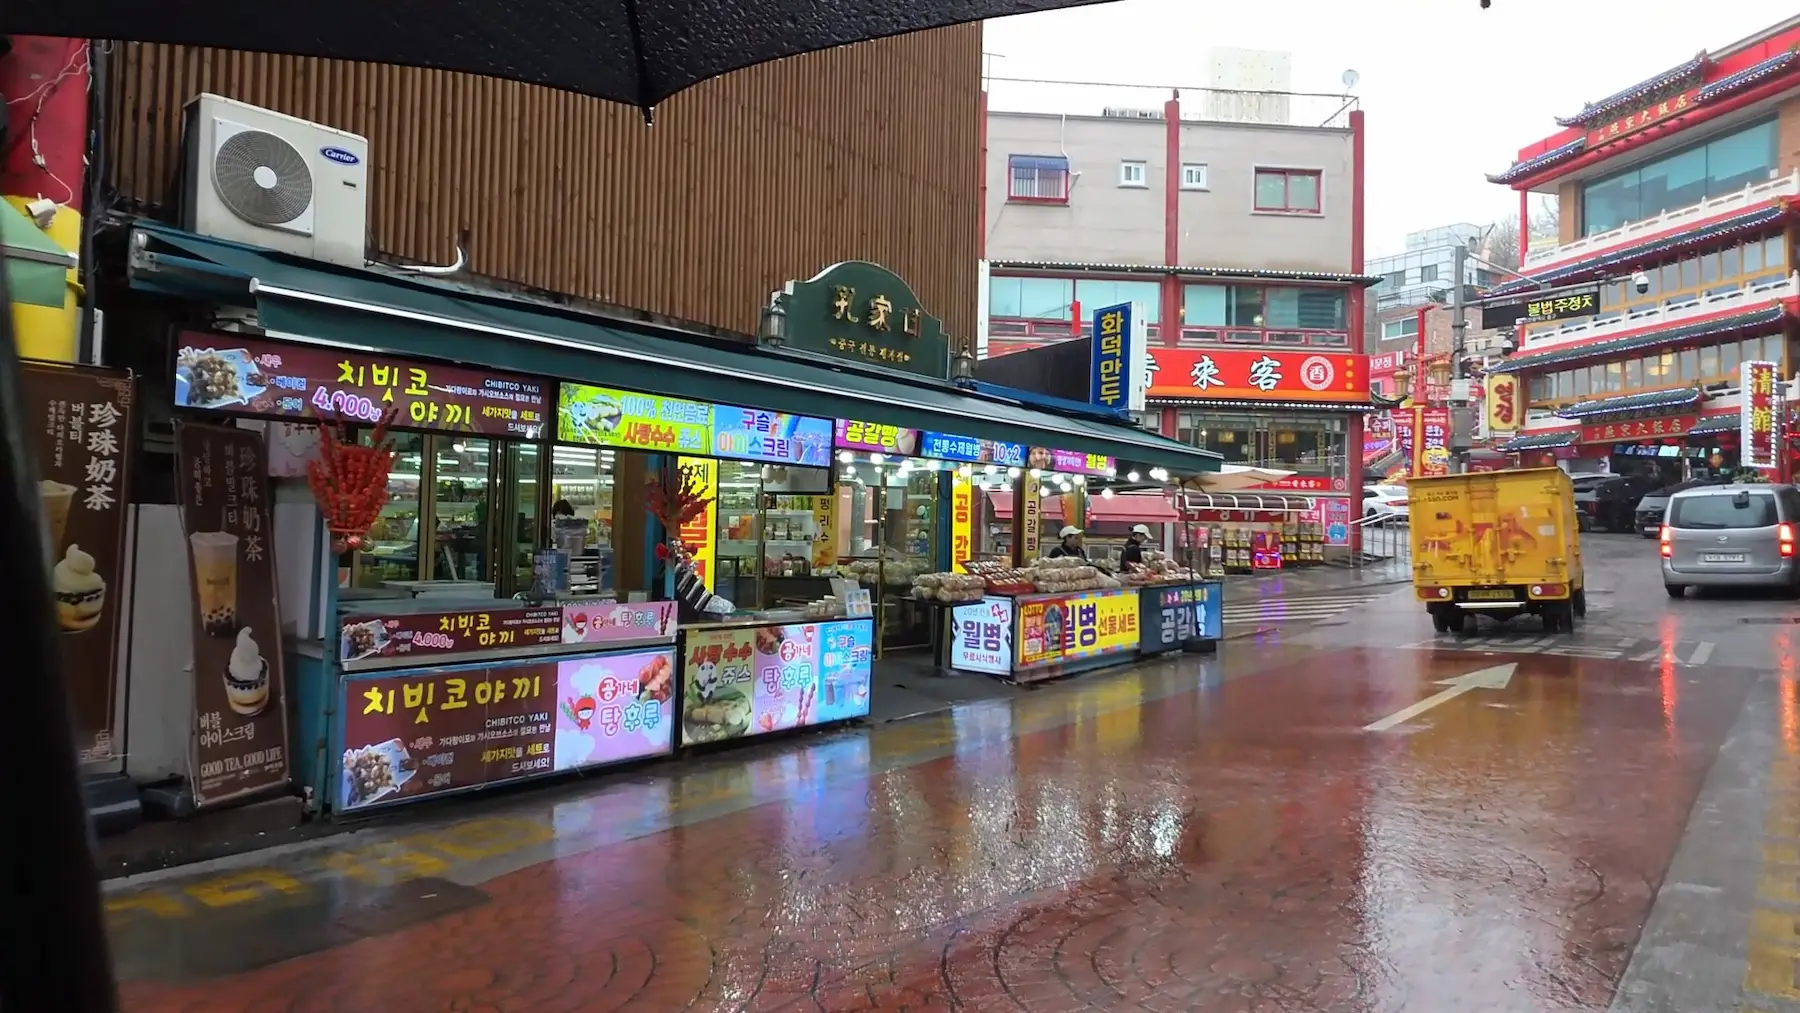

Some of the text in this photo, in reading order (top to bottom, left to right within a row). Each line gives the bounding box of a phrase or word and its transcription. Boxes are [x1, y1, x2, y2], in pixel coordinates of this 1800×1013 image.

[325, 149, 356, 163] Carrier
[1100, 311, 1124, 406] 화덕만두
[336, 359, 429, 403] 치빗코
[484, 379, 540, 394] CHIBITCO YAKI
[409, 401, 472, 425] 야끼
[620, 395, 657, 418] 100%
[1494, 381, 1514, 425] 연경
[69, 402, 85, 445] 버블티
[741, 410, 769, 433] 구슬
[846, 420, 898, 447] 공갈빵
[623, 422, 675, 447] 사탕수수
[718, 432, 789, 459] 아이스크림
[83, 401, 122, 511] 珍珠奶茶
[933, 438, 1021, 462] 전통수제월병 10+2
[1086, 453, 1107, 471] 월병
[240, 445, 264, 562] 珍珠奶茶
[1027, 500, 1037, 551] 공갈빵
[439, 614, 491, 637] 치빗코
[621, 608, 656, 629] 탕후루
[1065, 602, 1097, 649] 월병
[1099, 612, 1136, 637] 선물세트
[479, 630, 515, 645] 야끼
[839, 635, 855, 648] 구슬
[963, 620, 1001, 652] 월병
[688, 641, 753, 666] 사탕수수
[963, 651, 1002, 665] 무료시식행사
[721, 664, 751, 685] 쥬스
[762, 663, 813, 694] 탕후루
[363, 676, 541, 725] 치빗코야끼
[598, 676, 638, 702] 공가네
[199, 711, 222, 729] 버블
[485, 711, 548, 729] CHIBITCO YAKI
[600, 701, 660, 737] 탕후루
[200, 722, 255, 748] 아이스크림
[201, 760, 223, 778] GOOD
[243, 750, 265, 768] GOOD
[265, 746, 283, 763] LIFE
